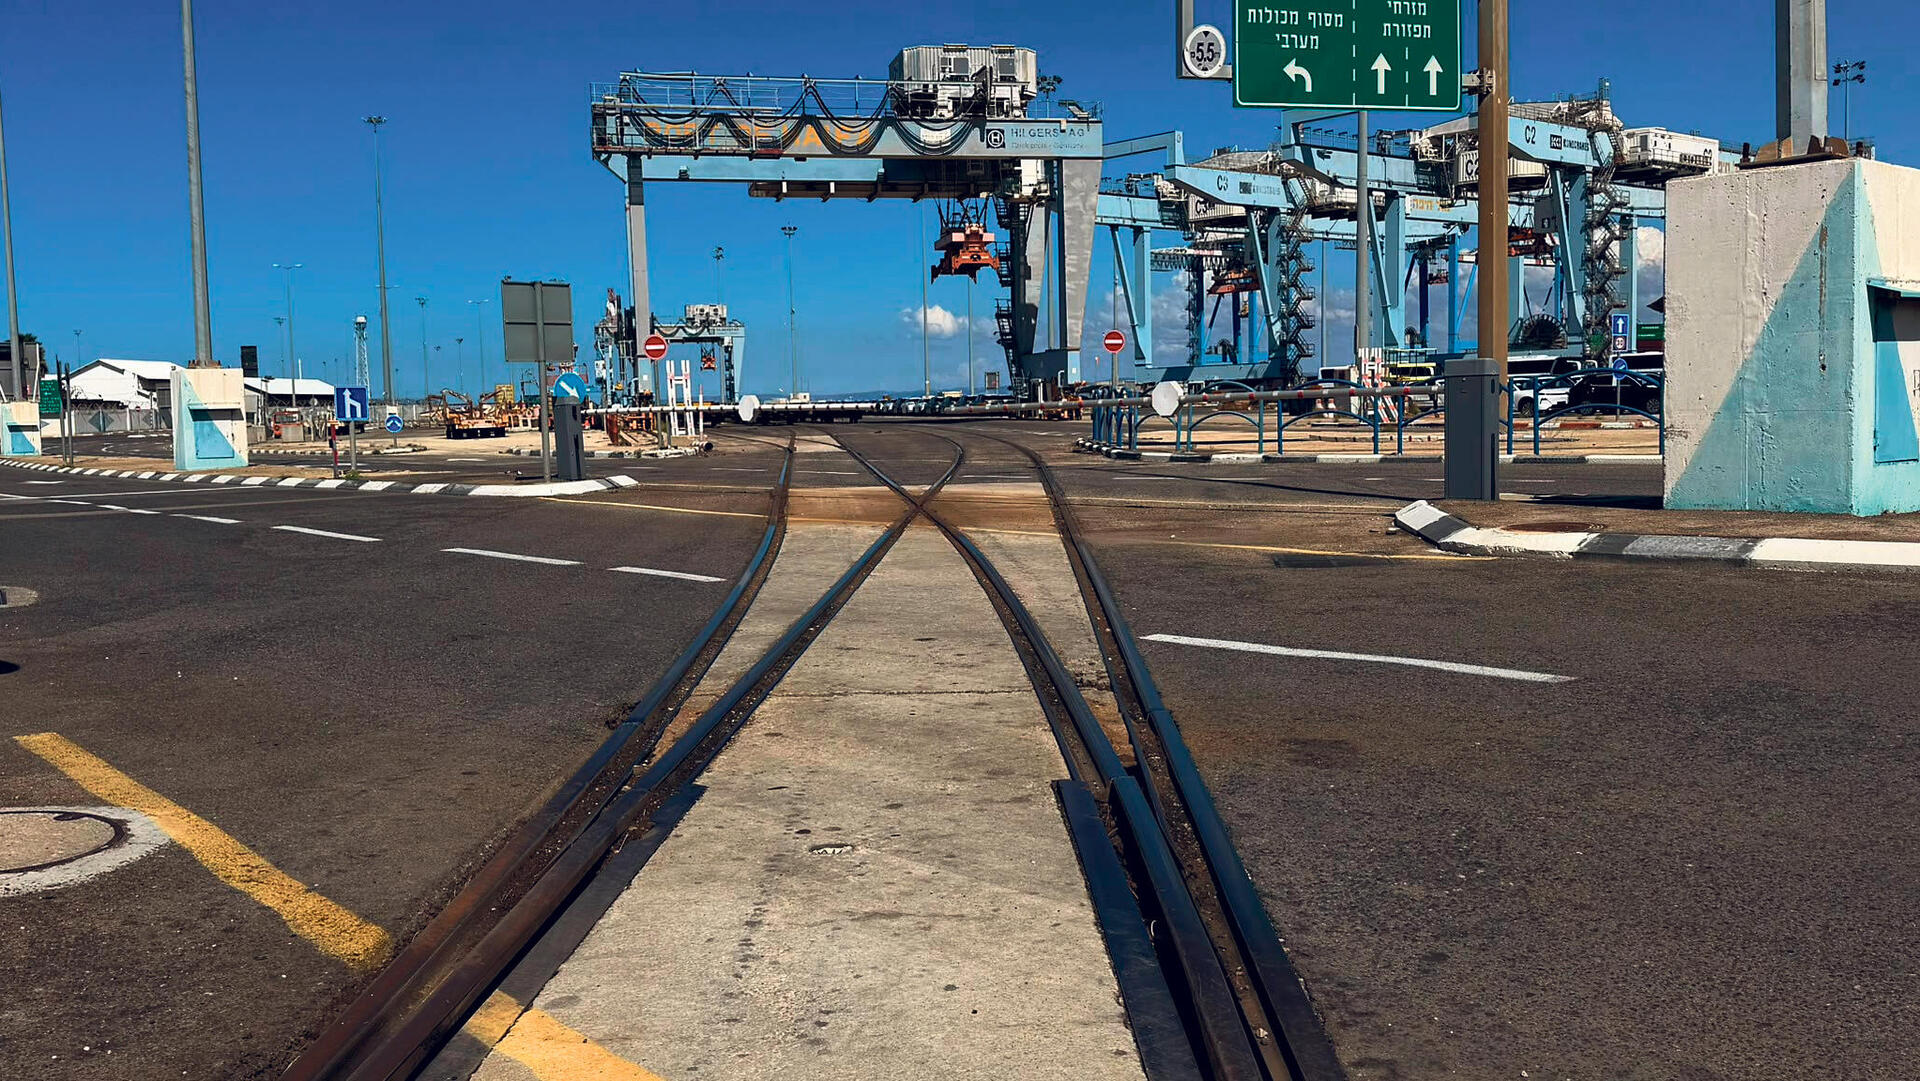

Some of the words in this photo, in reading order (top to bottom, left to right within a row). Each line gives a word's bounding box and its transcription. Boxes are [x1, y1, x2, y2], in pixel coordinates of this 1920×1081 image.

[1247, 6, 1299, 25] מכולות
[1387, 0, 1427, 16] מזרחי
[1308, 12, 1343, 28] מסוף
[1383, 23, 1431, 39] תפזורת
[1275, 33, 1319, 49] מערבי
[1196, 42, 1215, 62] 5.5
[1011, 128, 1060, 138] HILGERS
[1069, 128, 1085, 137] AG
[1524, 125, 1536, 144] C2
[1216, 174, 1229, 191] C3
